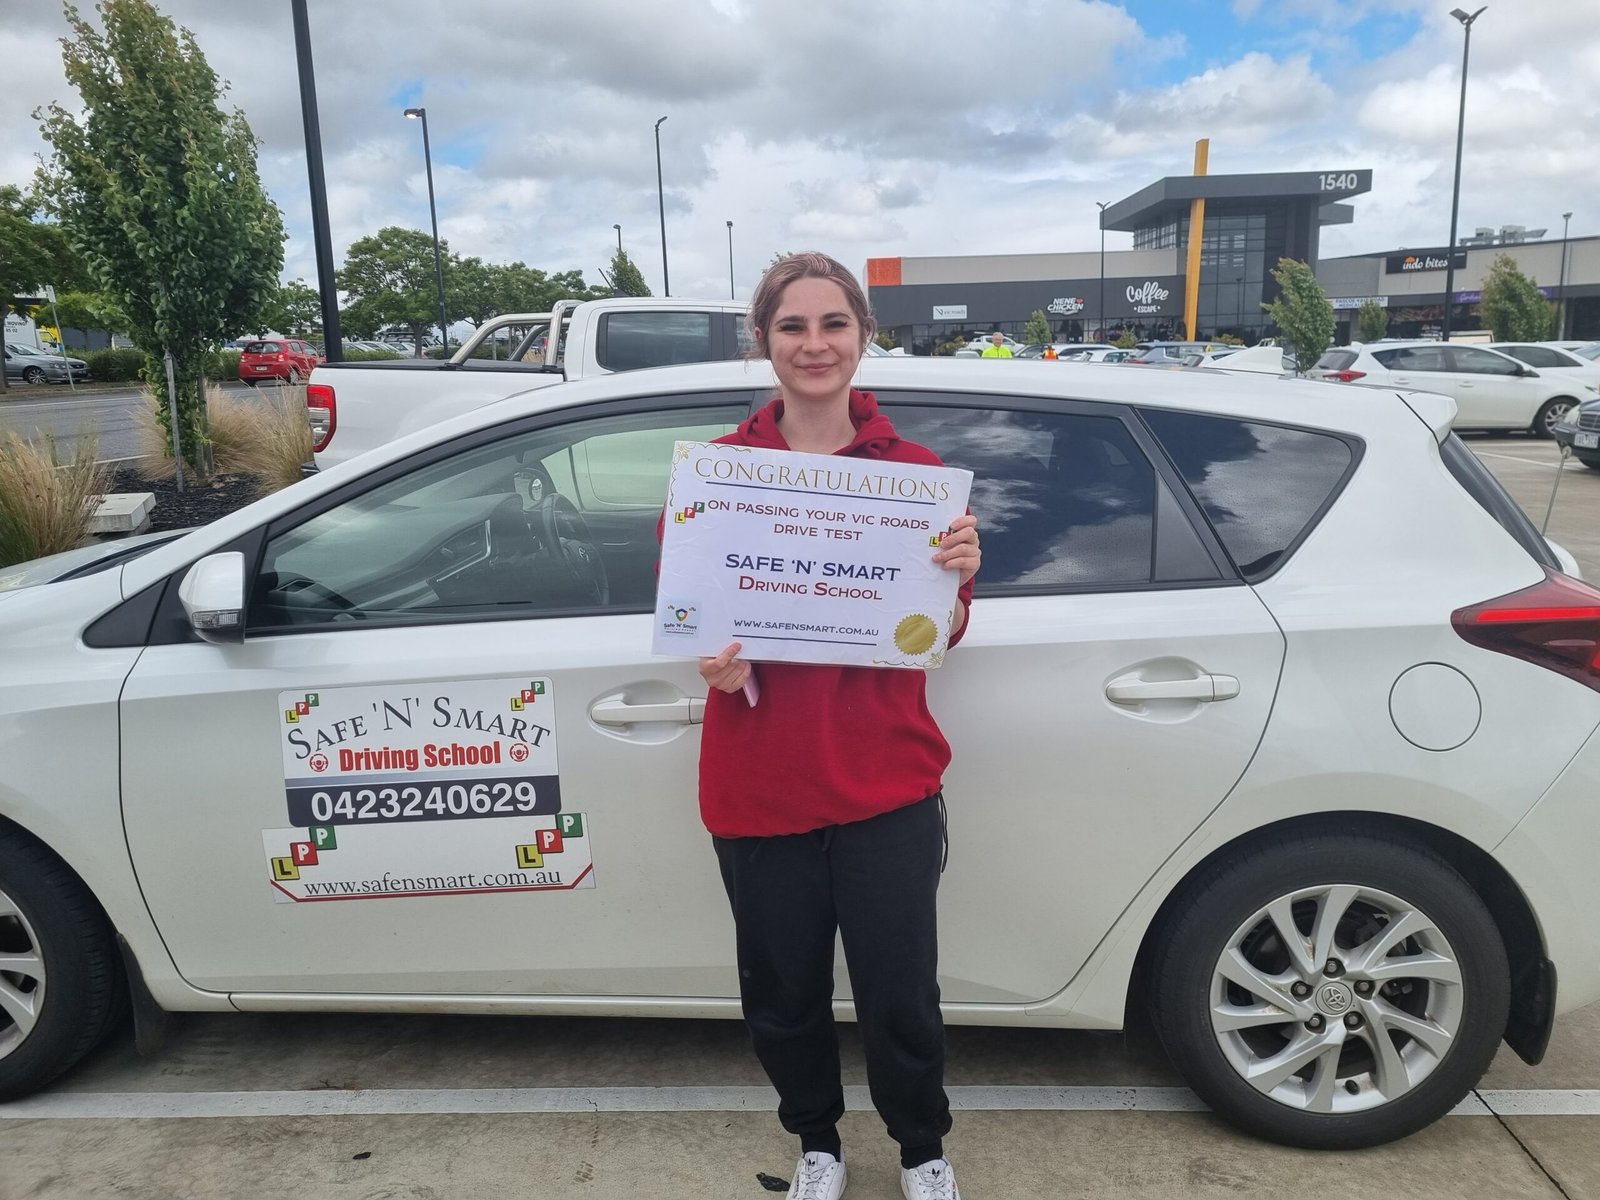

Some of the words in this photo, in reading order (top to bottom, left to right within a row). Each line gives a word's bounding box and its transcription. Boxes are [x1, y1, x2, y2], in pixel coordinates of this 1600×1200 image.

[1319, 173, 1358, 190] 1540
[1402, 257, 1424, 270] indo
[1425, 256, 1448, 268] bites
[1053, 297, 1077, 305] NENE
[1126, 281, 1169, 304] Coffee
[1047, 303, 1084, 311] CHICKEN
[1137, 305, 1157, 313] ESCAPE
[695, 457, 951, 502] CONGRATULATIONS
[708, 499, 730, 511] ON
[736, 502, 800, 519] PASSING
[806, 509, 846, 523] YOUR
[852, 513, 874, 526] VIC
[880, 517, 929, 530] ROADS
[774, 524, 818, 538] DRIVE
[824, 527, 863, 541] TEST
[725, 553, 784, 572] SAFE
[822, 562, 901, 582] SMART
[733, 618, 879, 637] WWW.SAFENSMART.COM.AU
[338, 747, 419, 772] Driving
[423, 741, 501, 767] School
[311, 781, 537, 822] 0423240629
[522, 846, 536, 864] L
[542, 831, 555, 849] P
[562, 815, 575, 833] P
[278, 859, 292, 876] L
[297, 844, 310, 861] P
[316, 828, 328, 846] P
[304, 870, 562, 896] www.safensmart.com.au
